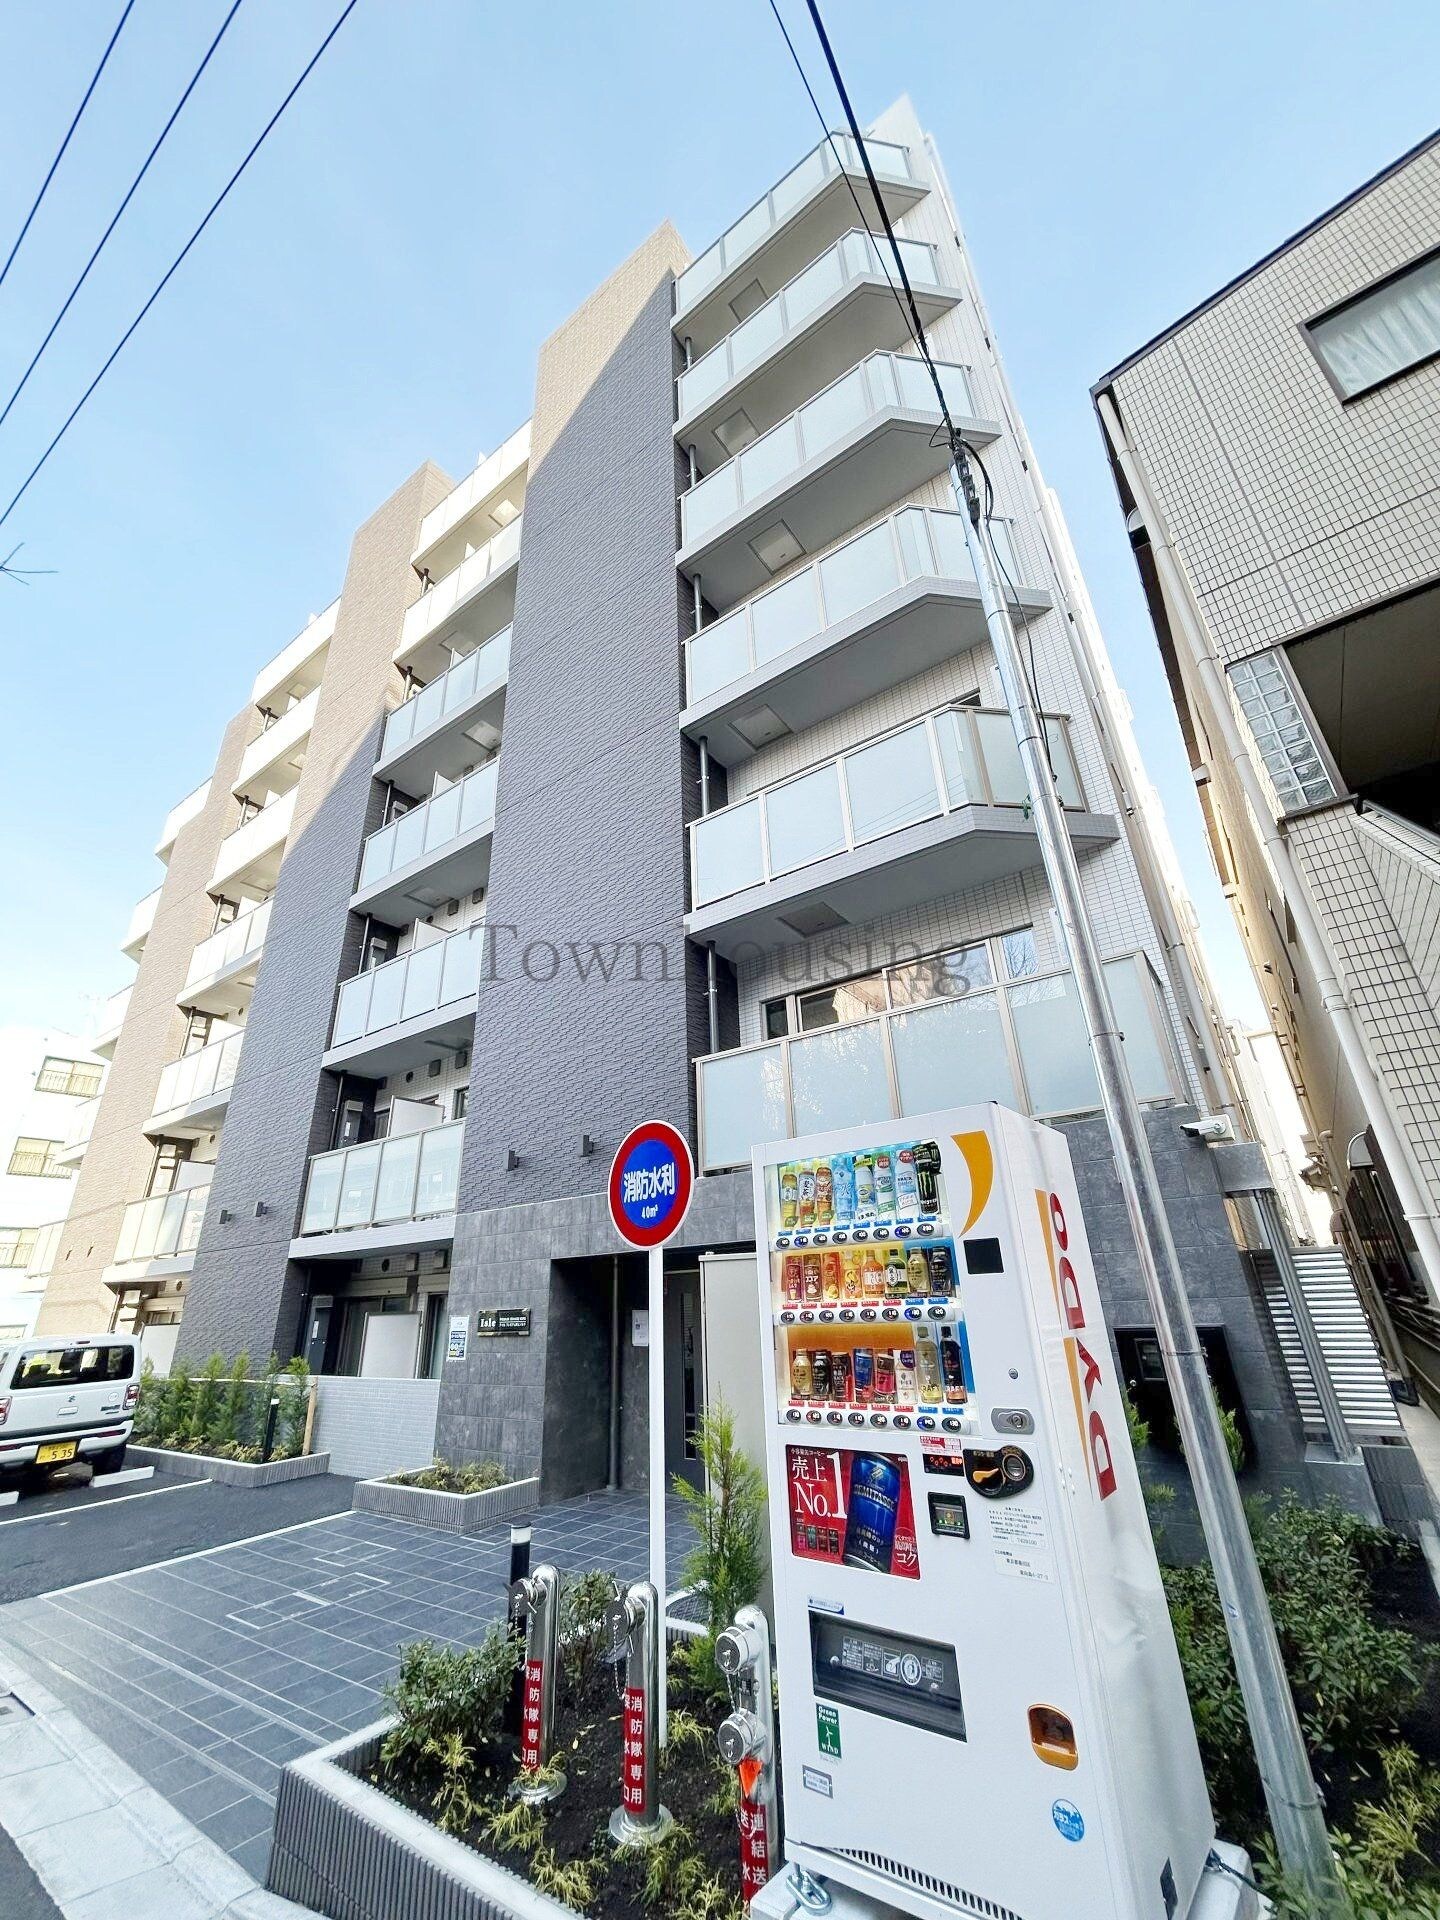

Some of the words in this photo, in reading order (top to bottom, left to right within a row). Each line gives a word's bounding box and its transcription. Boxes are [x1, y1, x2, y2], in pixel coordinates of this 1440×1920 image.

[624, 1162, 675, 1203] 消防水利
[479, 1318, 497, 1328] Isle
[792, 1455, 828, 1483] 売上
[896, 1552, 917, 1567] コク
[527, 1667, 541, 1764] 消防隊専用
[818, 1706, 837, 1718] Green
[818, 1713, 838, 1725] Power
[630, 1696, 643, 1804] 消防隊専用
